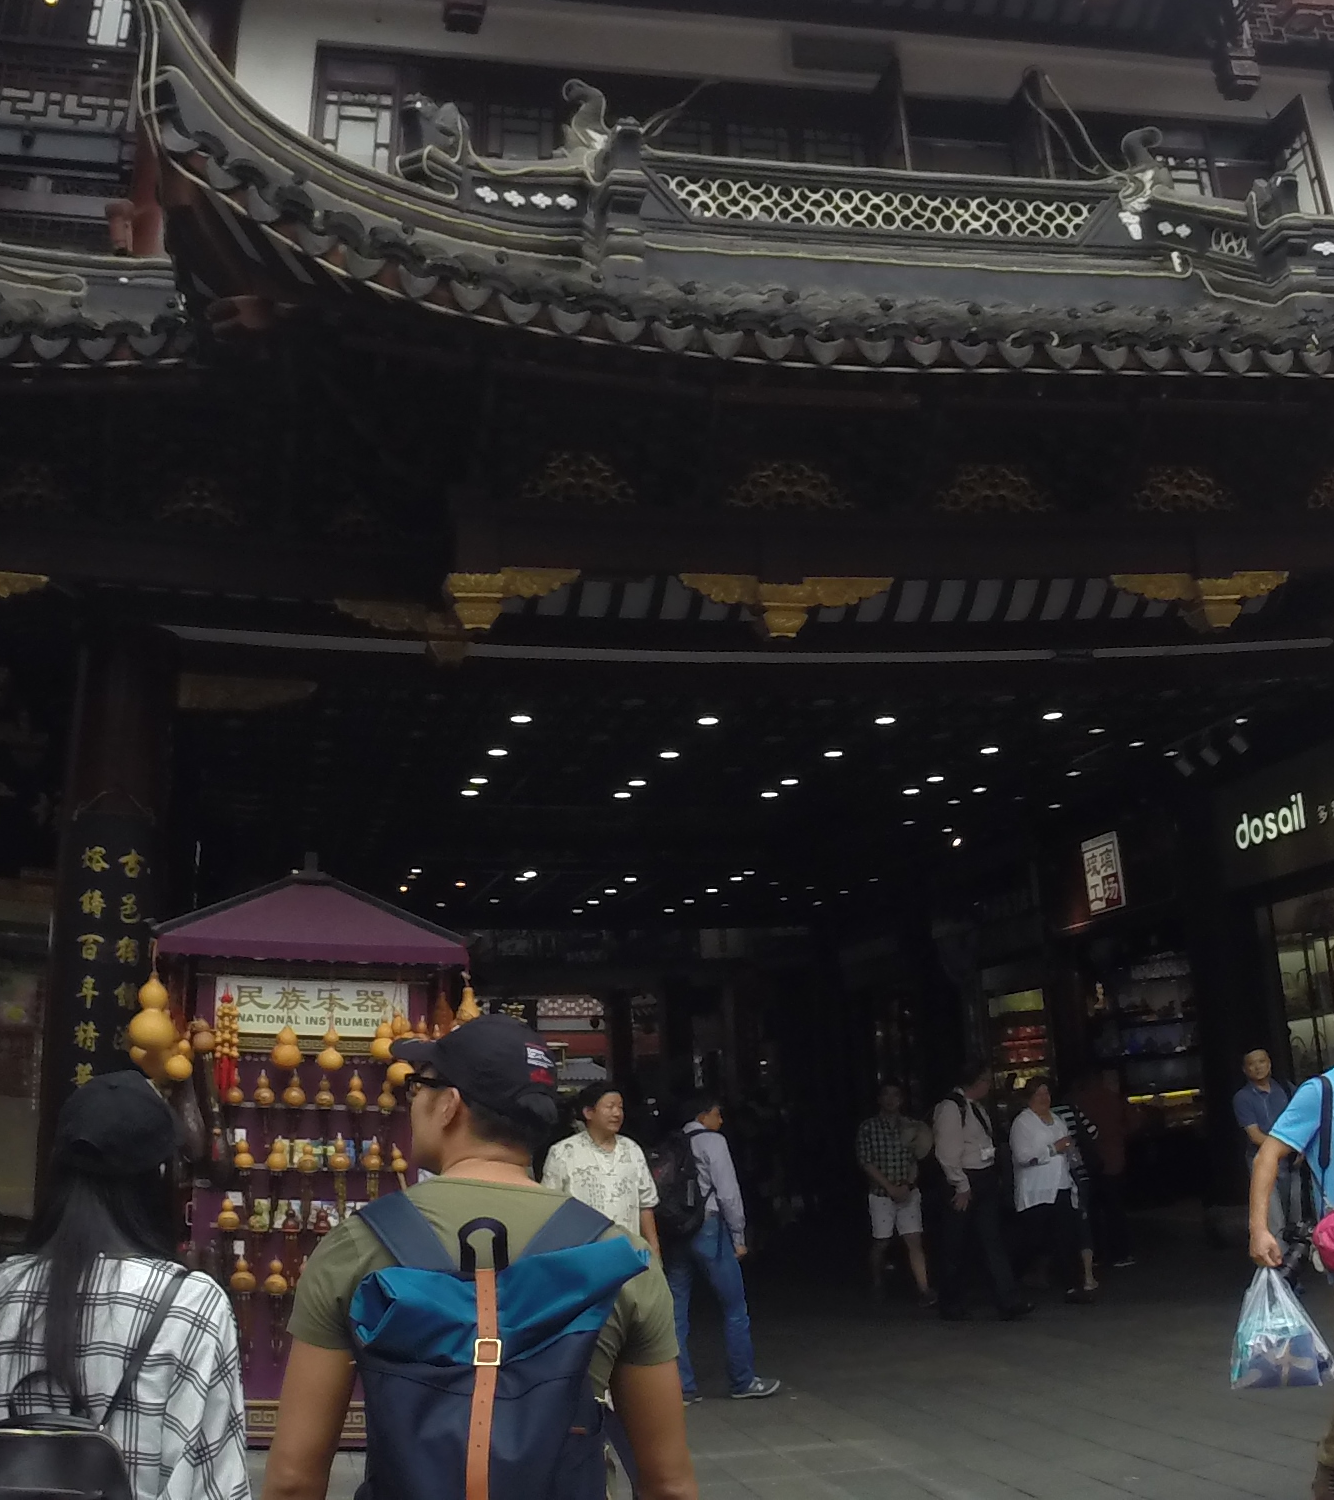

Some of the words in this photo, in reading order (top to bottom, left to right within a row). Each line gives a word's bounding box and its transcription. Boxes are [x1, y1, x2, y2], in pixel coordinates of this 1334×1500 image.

[1235, 792, 1306, 849] dosail
[236, 984, 388, 1013] 民族乐器
[237, 1012, 300, 1026] NATIONAL
[305, 1015, 385, 1028] INSRUMEN
